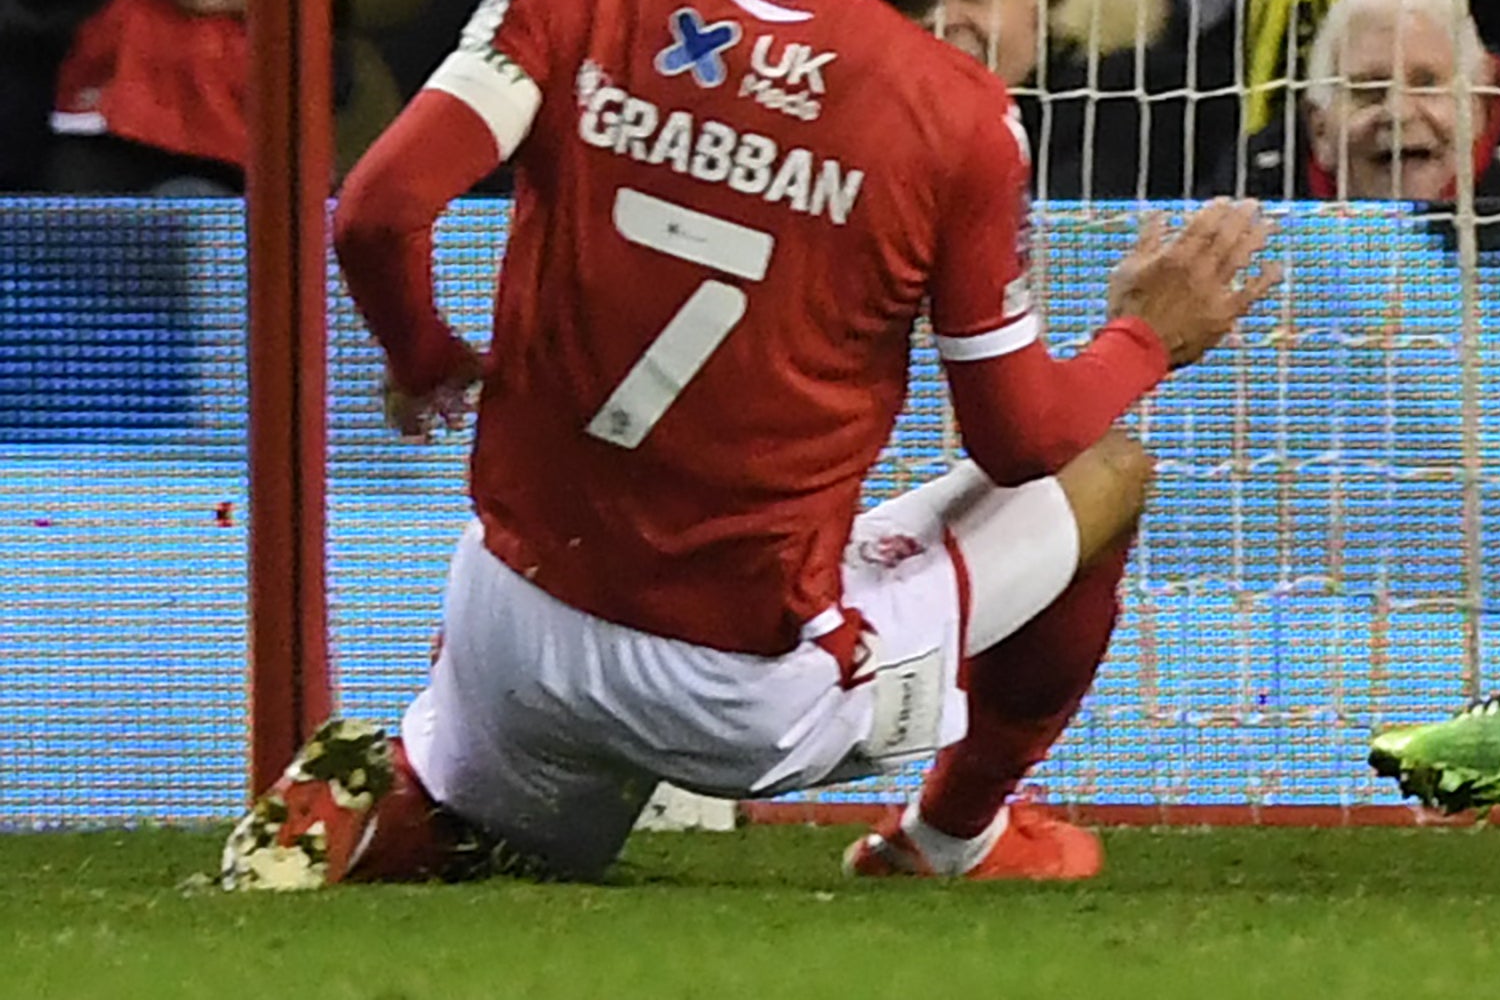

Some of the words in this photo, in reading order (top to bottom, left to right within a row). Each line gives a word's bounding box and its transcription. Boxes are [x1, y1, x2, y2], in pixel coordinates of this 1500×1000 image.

[751, 34, 838, 94] UK
[578, 86, 865, 225] GRABBAN
[584, 186, 776, 449] 7
